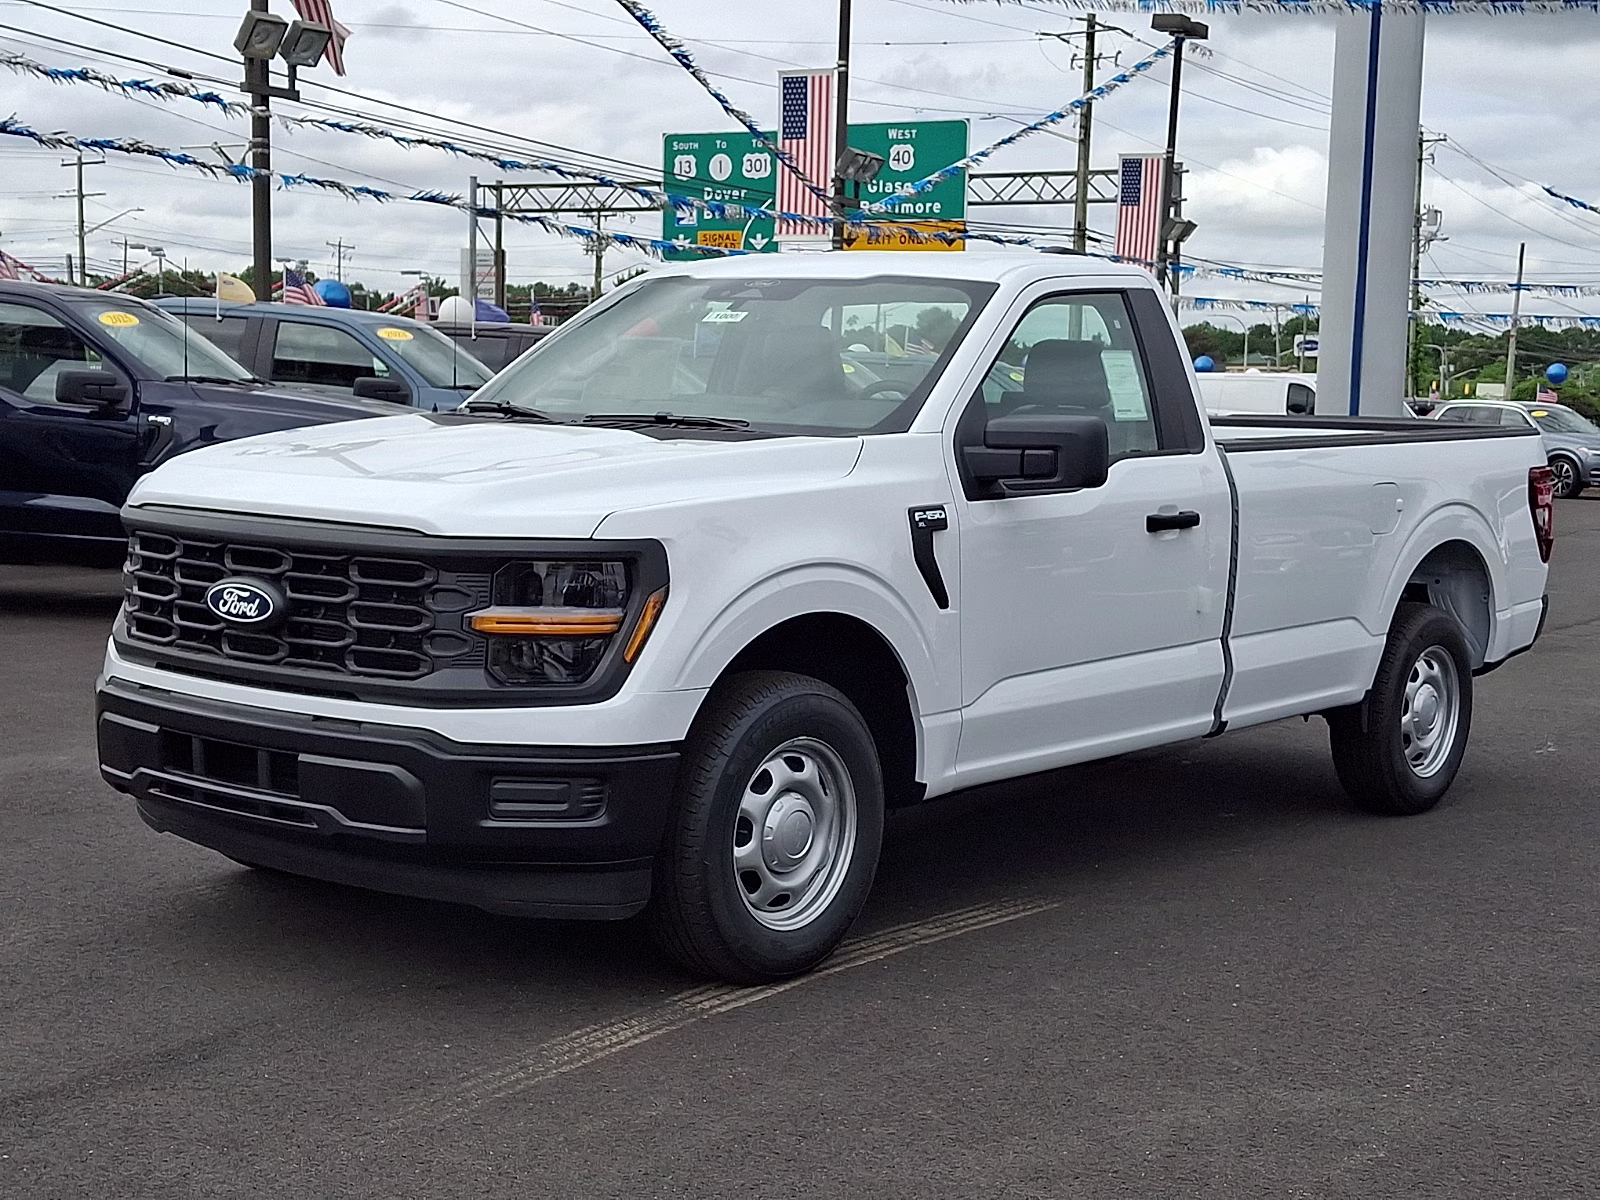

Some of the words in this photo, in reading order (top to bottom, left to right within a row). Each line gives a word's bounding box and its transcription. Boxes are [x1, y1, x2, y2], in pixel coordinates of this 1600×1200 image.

[888, 129, 917, 139] WEST
[892, 150, 911, 165] 40
[679, 160, 692, 174] 13
[745, 159, 768, 173] 301
[703, 187, 747, 201] Dover
[702, 233, 737, 242] SIGNAL
[218, 587, 260, 618] Ford
